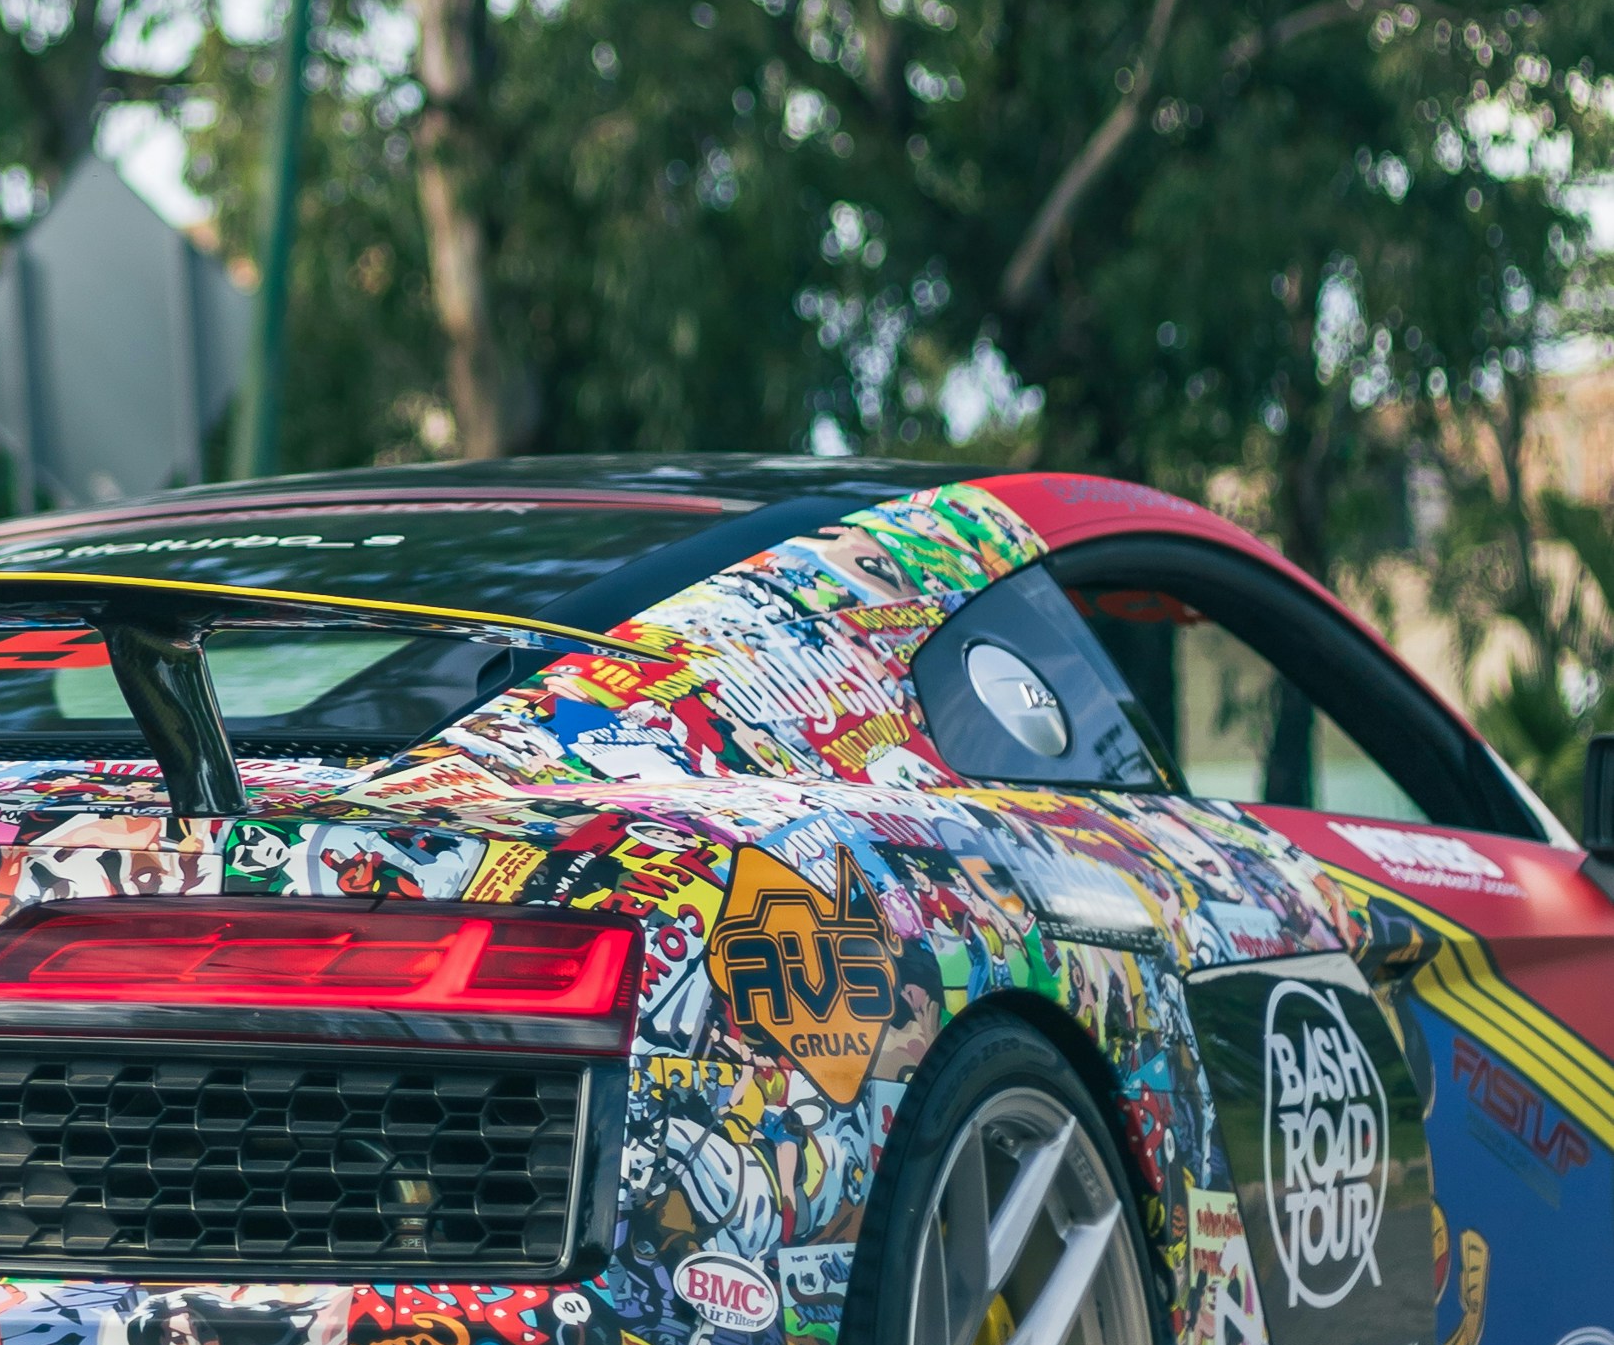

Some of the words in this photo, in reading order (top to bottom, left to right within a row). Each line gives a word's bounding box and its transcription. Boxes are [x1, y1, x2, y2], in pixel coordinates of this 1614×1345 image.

[790, 1031, 871, 1057] GRUAS
[1268, 1020, 1371, 1113] BASH
[1283, 1103, 1379, 1190] ROAD
[1285, 1182, 1376, 1267] TOUR
[686, 1267, 766, 1316] BMC
